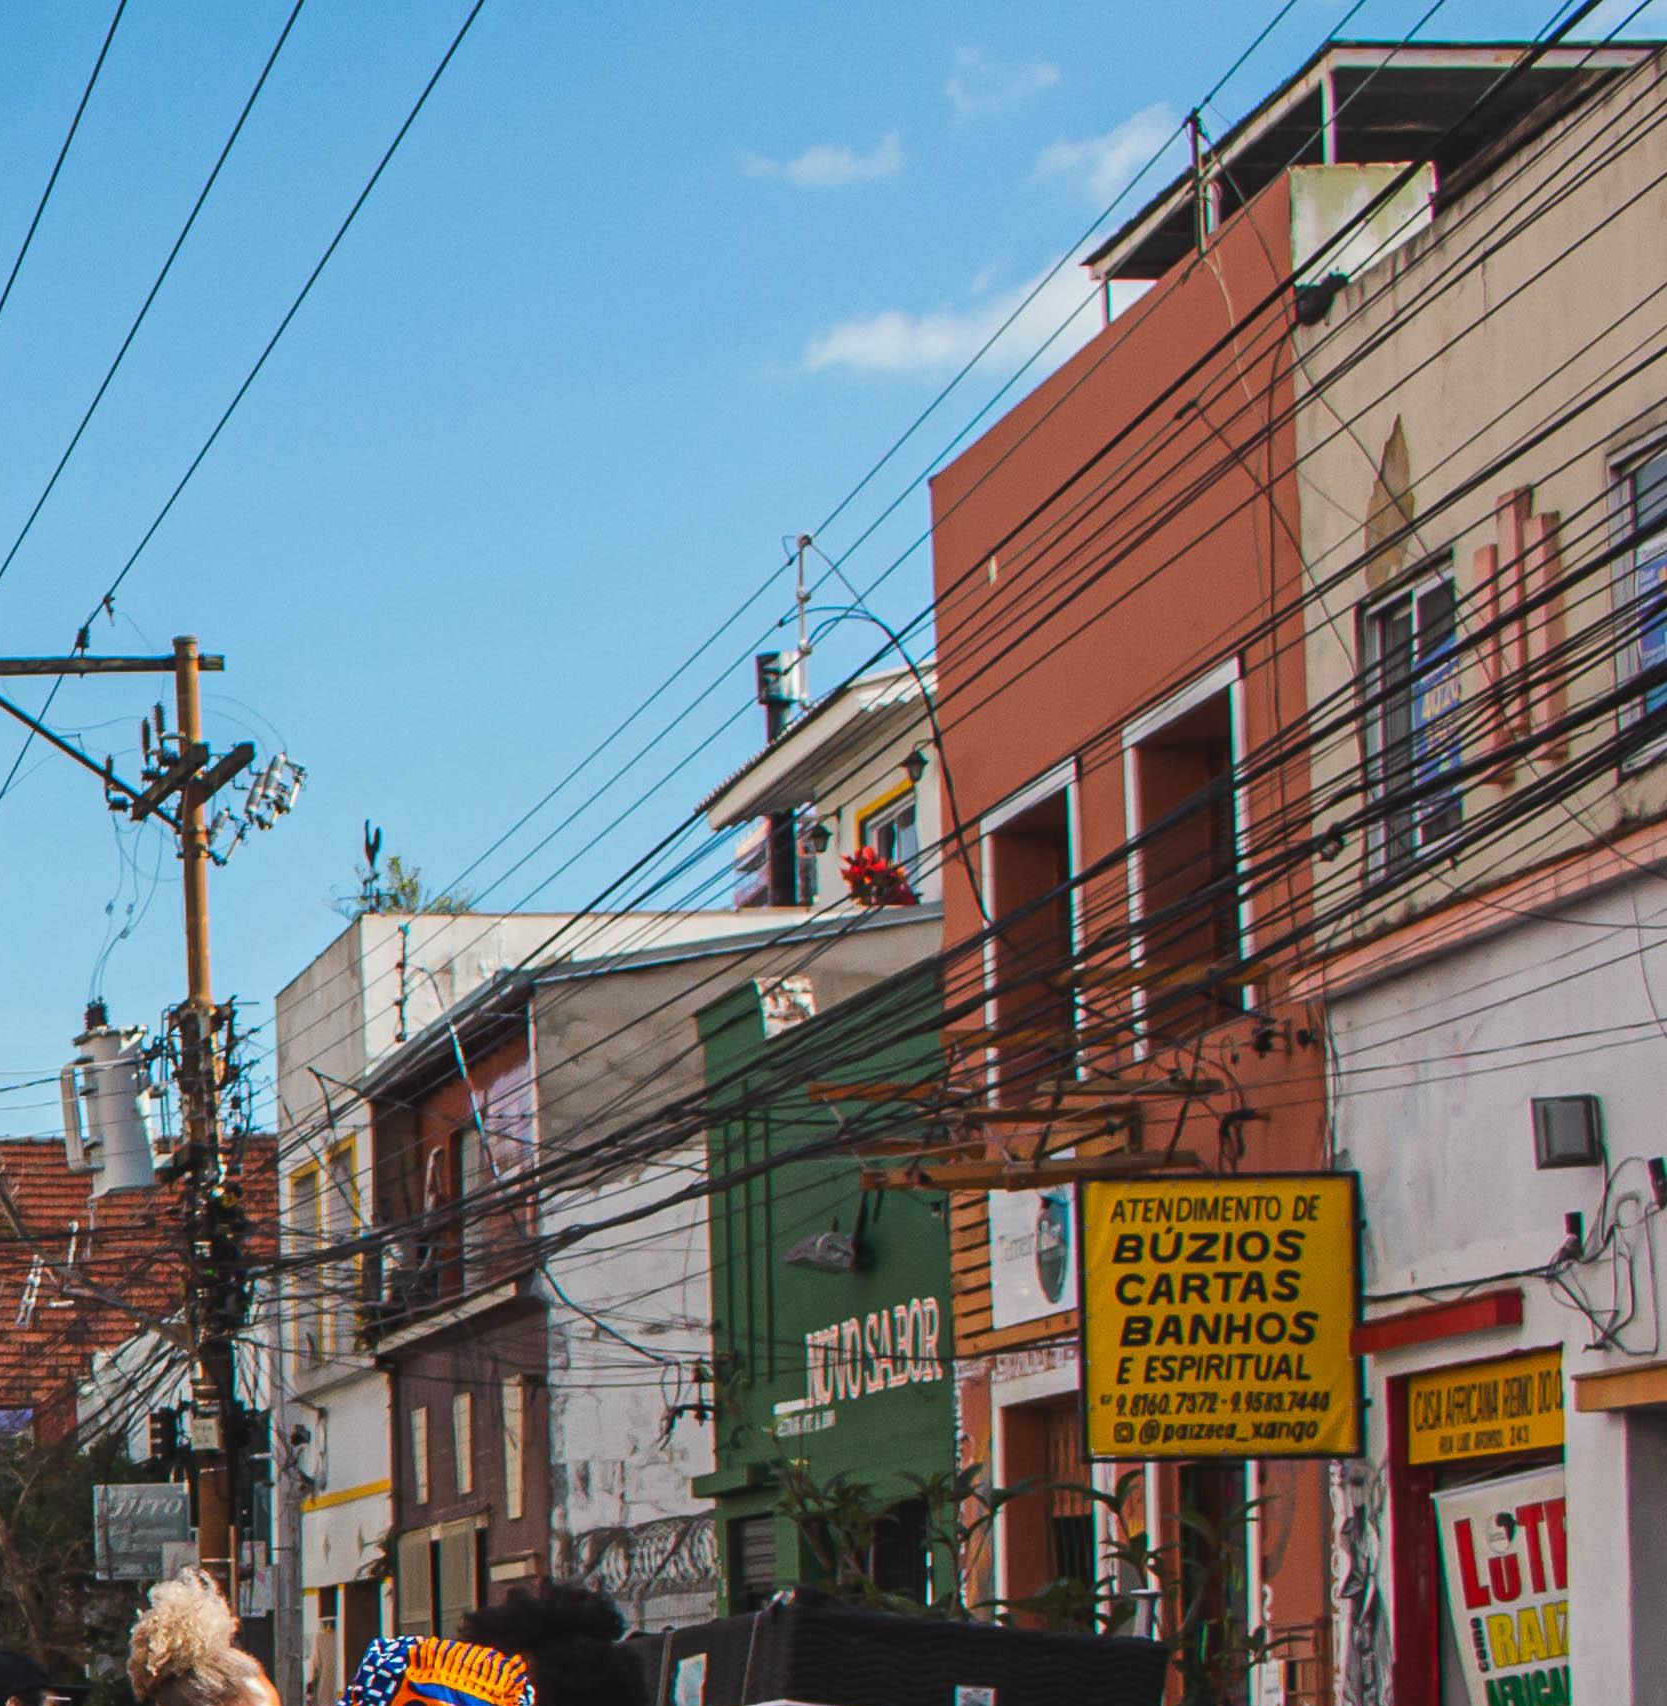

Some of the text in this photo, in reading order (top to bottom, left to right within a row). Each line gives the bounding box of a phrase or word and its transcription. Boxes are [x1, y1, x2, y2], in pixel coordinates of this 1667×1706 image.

[1110, 1195, 1320, 1223] ATENDIMENTO DE
[1112, 1227, 1306, 1264] BÚZIOS
[1115, 1269, 1302, 1306] CARTAS
[1120, 1311, 1320, 1347] BANHOS
[805, 1317, 863, 1409] NOVO
[864, 1296, 943, 1395] SABOR
[1117, 1353, 1312, 1385] E ESPIRITUAL
[1414, 1388, 1443, 1432] CASA
[1445, 1380, 1499, 1427] AFRICANA
